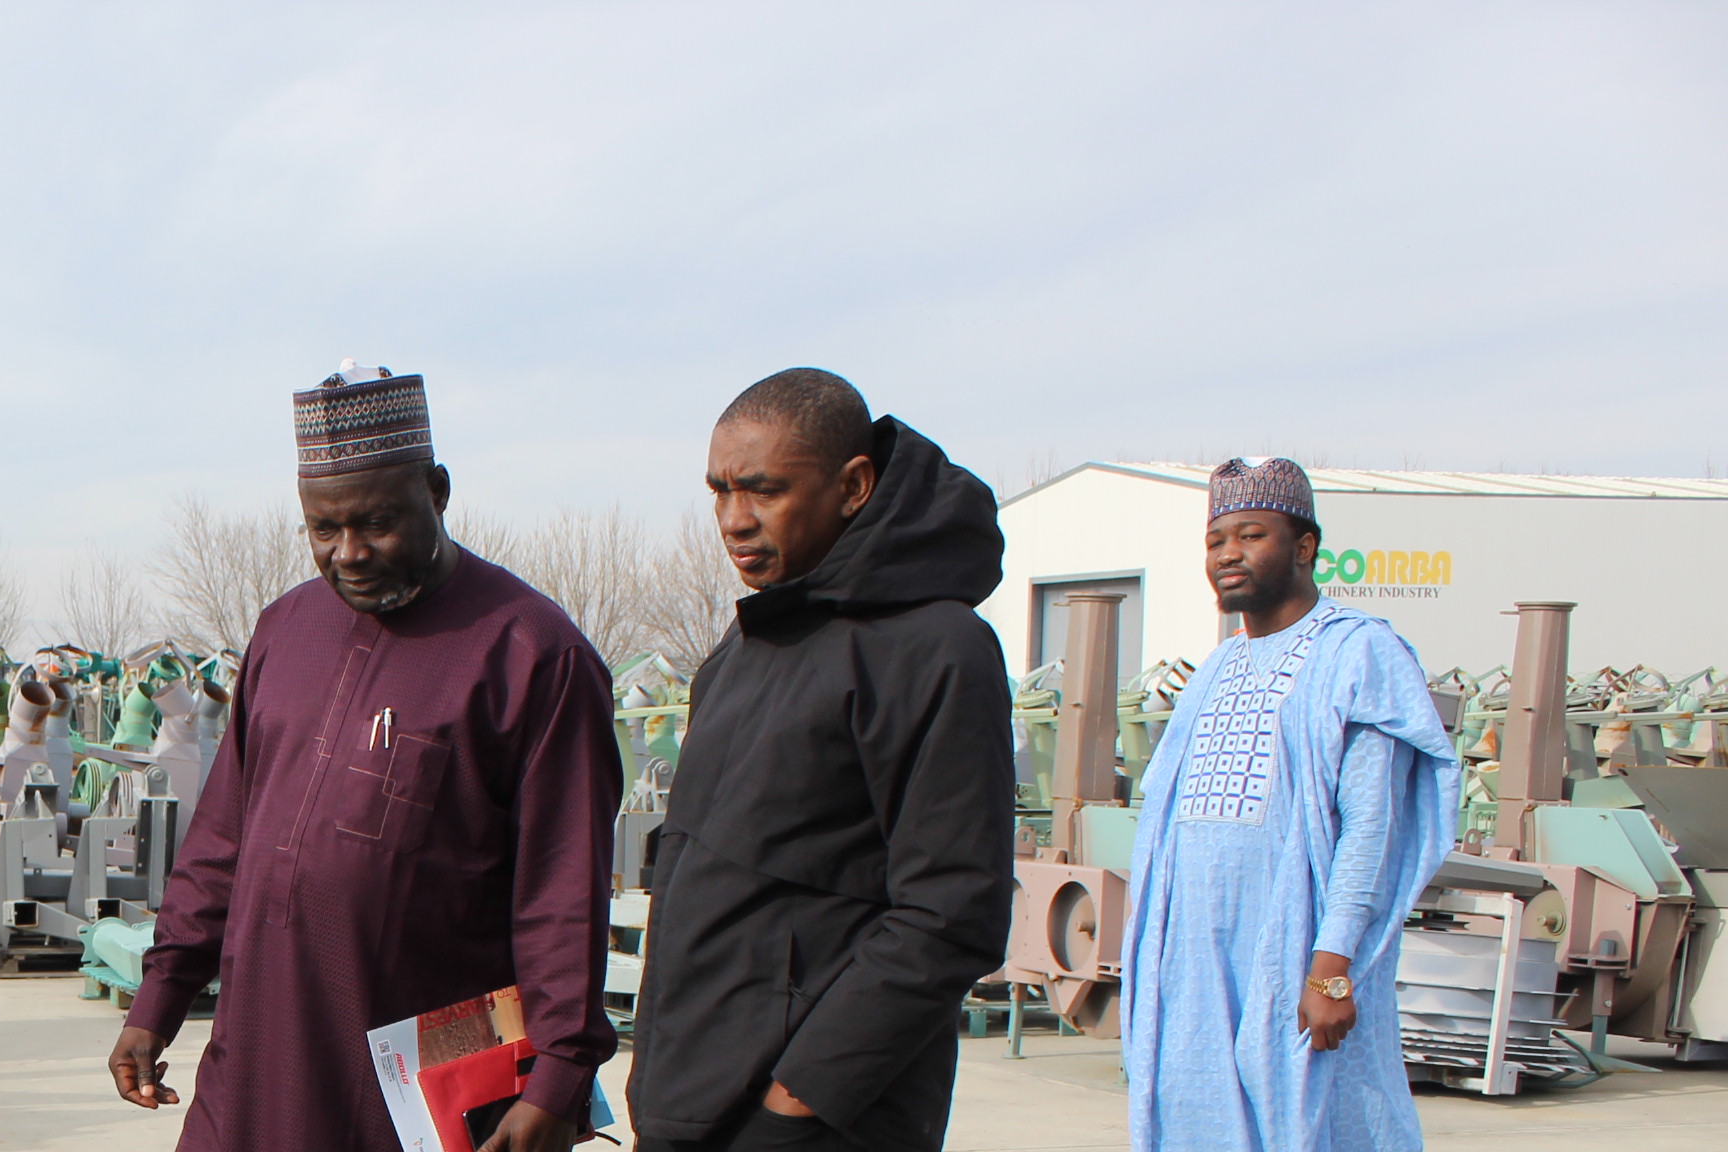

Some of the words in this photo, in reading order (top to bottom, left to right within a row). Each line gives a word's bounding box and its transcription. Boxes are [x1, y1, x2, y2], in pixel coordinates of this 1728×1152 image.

[1312, 548, 1452, 585] COARBA
[1319, 586, 1377, 598] CHINERY
[1378, 586, 1442, 599] INDUSTRY
[496, 988, 511, 999] TO
